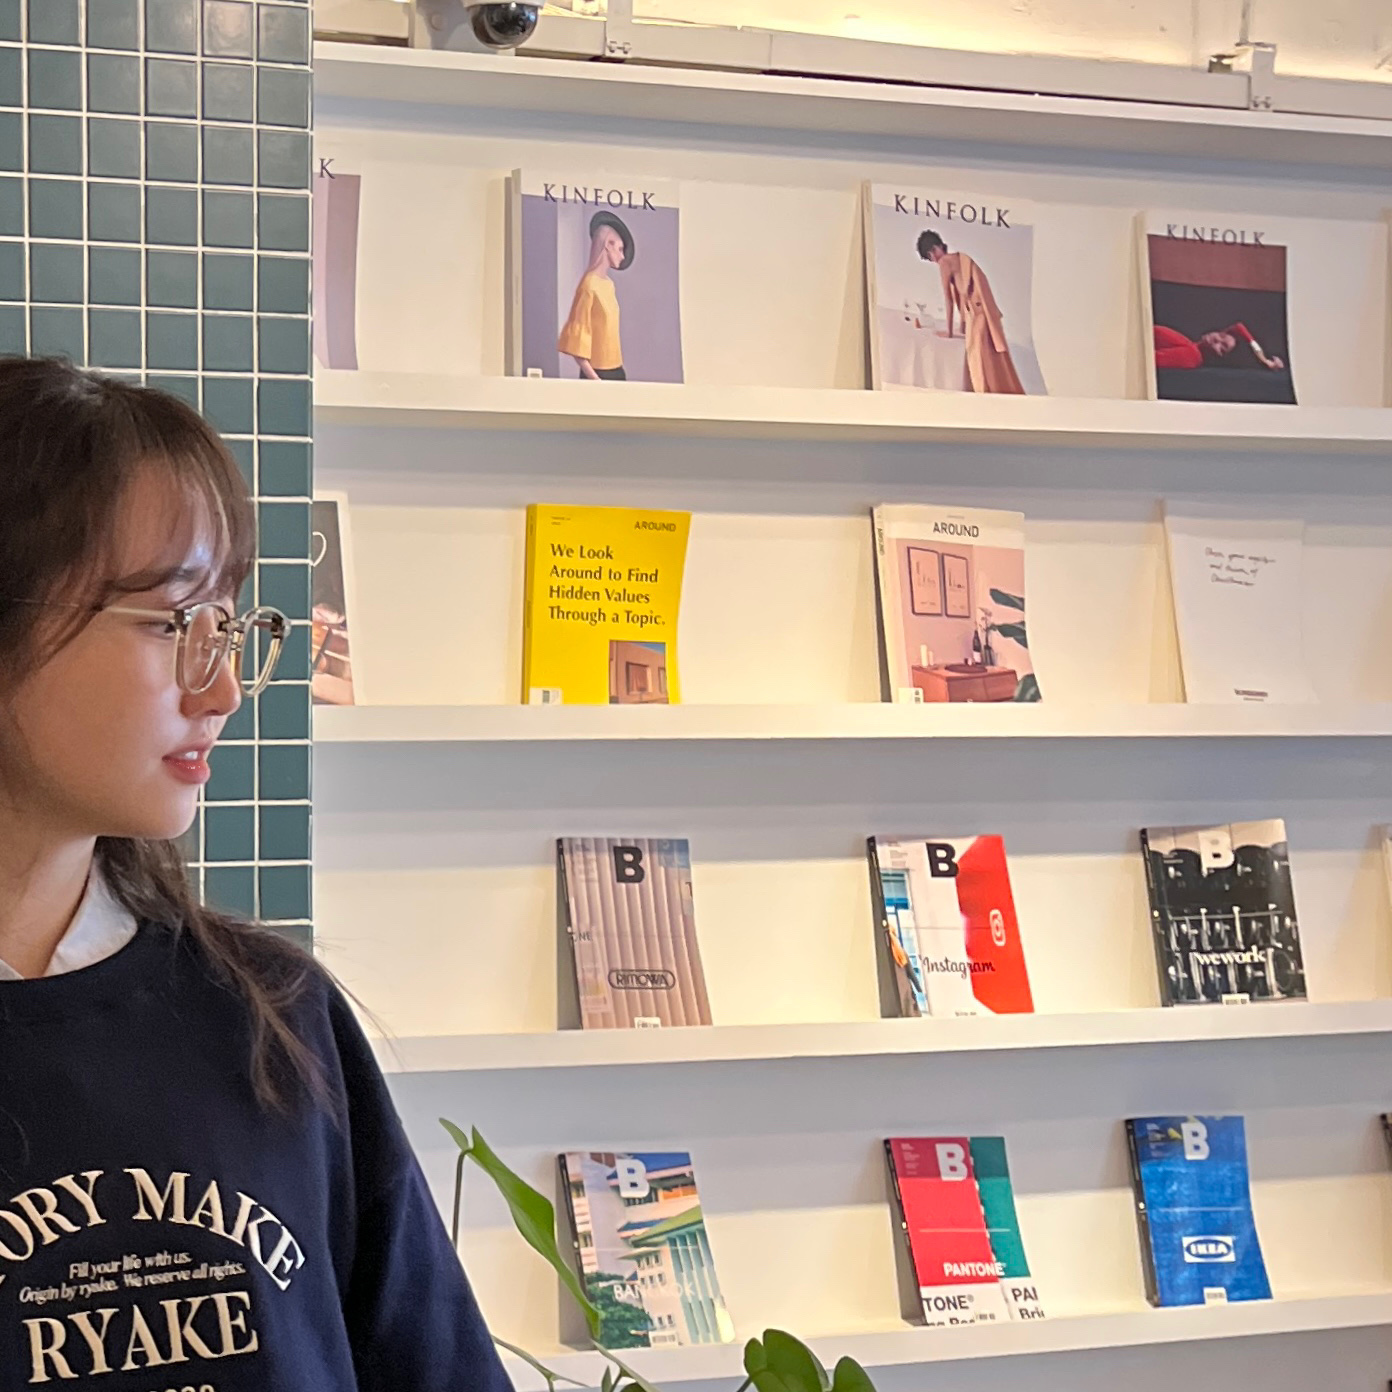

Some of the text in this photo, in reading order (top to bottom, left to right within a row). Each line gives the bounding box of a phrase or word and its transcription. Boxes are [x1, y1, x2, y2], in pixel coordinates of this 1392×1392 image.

[543, 182, 657, 211] KINFOLK
[894, 194, 1011, 229] KINFOLK
[1166, 224, 1266, 248] KINFOLK
[634, 521, 677, 532] AROUND
[932, 521, 980, 538] AROUND
[550, 543, 614, 560] We Look
[550, 564, 659, 583] Around to Find
[549, 585, 650, 604] Hidden Values
[548, 605, 666, 628] Through a Topic.
[925, 842, 960, 878] B
[1198, 830, 1236, 869] B
[613, 845, 646, 884] B
[919, 954, 996, 979] Instagram
[1194, 944, 1268, 966] wework
[615, 973, 670, 987] RIMOWA
[1180, 1121, 1210, 1160] B
[934, 1142, 969, 1182] B
[616, 1159, 651, 1198] B
[122, 1167, 307, 1291] MAKE
[69, 1262, 89, 1280] Fill
[90, 1259, 122, 1279] your
[122, 1253, 142, 1272] life
[144, 1250, 172, 1268] with
[943, 1261, 1006, 1278] PANTONE
[19, 1285, 59, 1305] Origin
[61, 1282, 78, 1301] by
[123, 1273, 143, 1288] We
[144, 1268, 190, 1286] reserve
[191, 1262, 208, 1280] all
[21, 1291, 259, 1384] RYAKE
